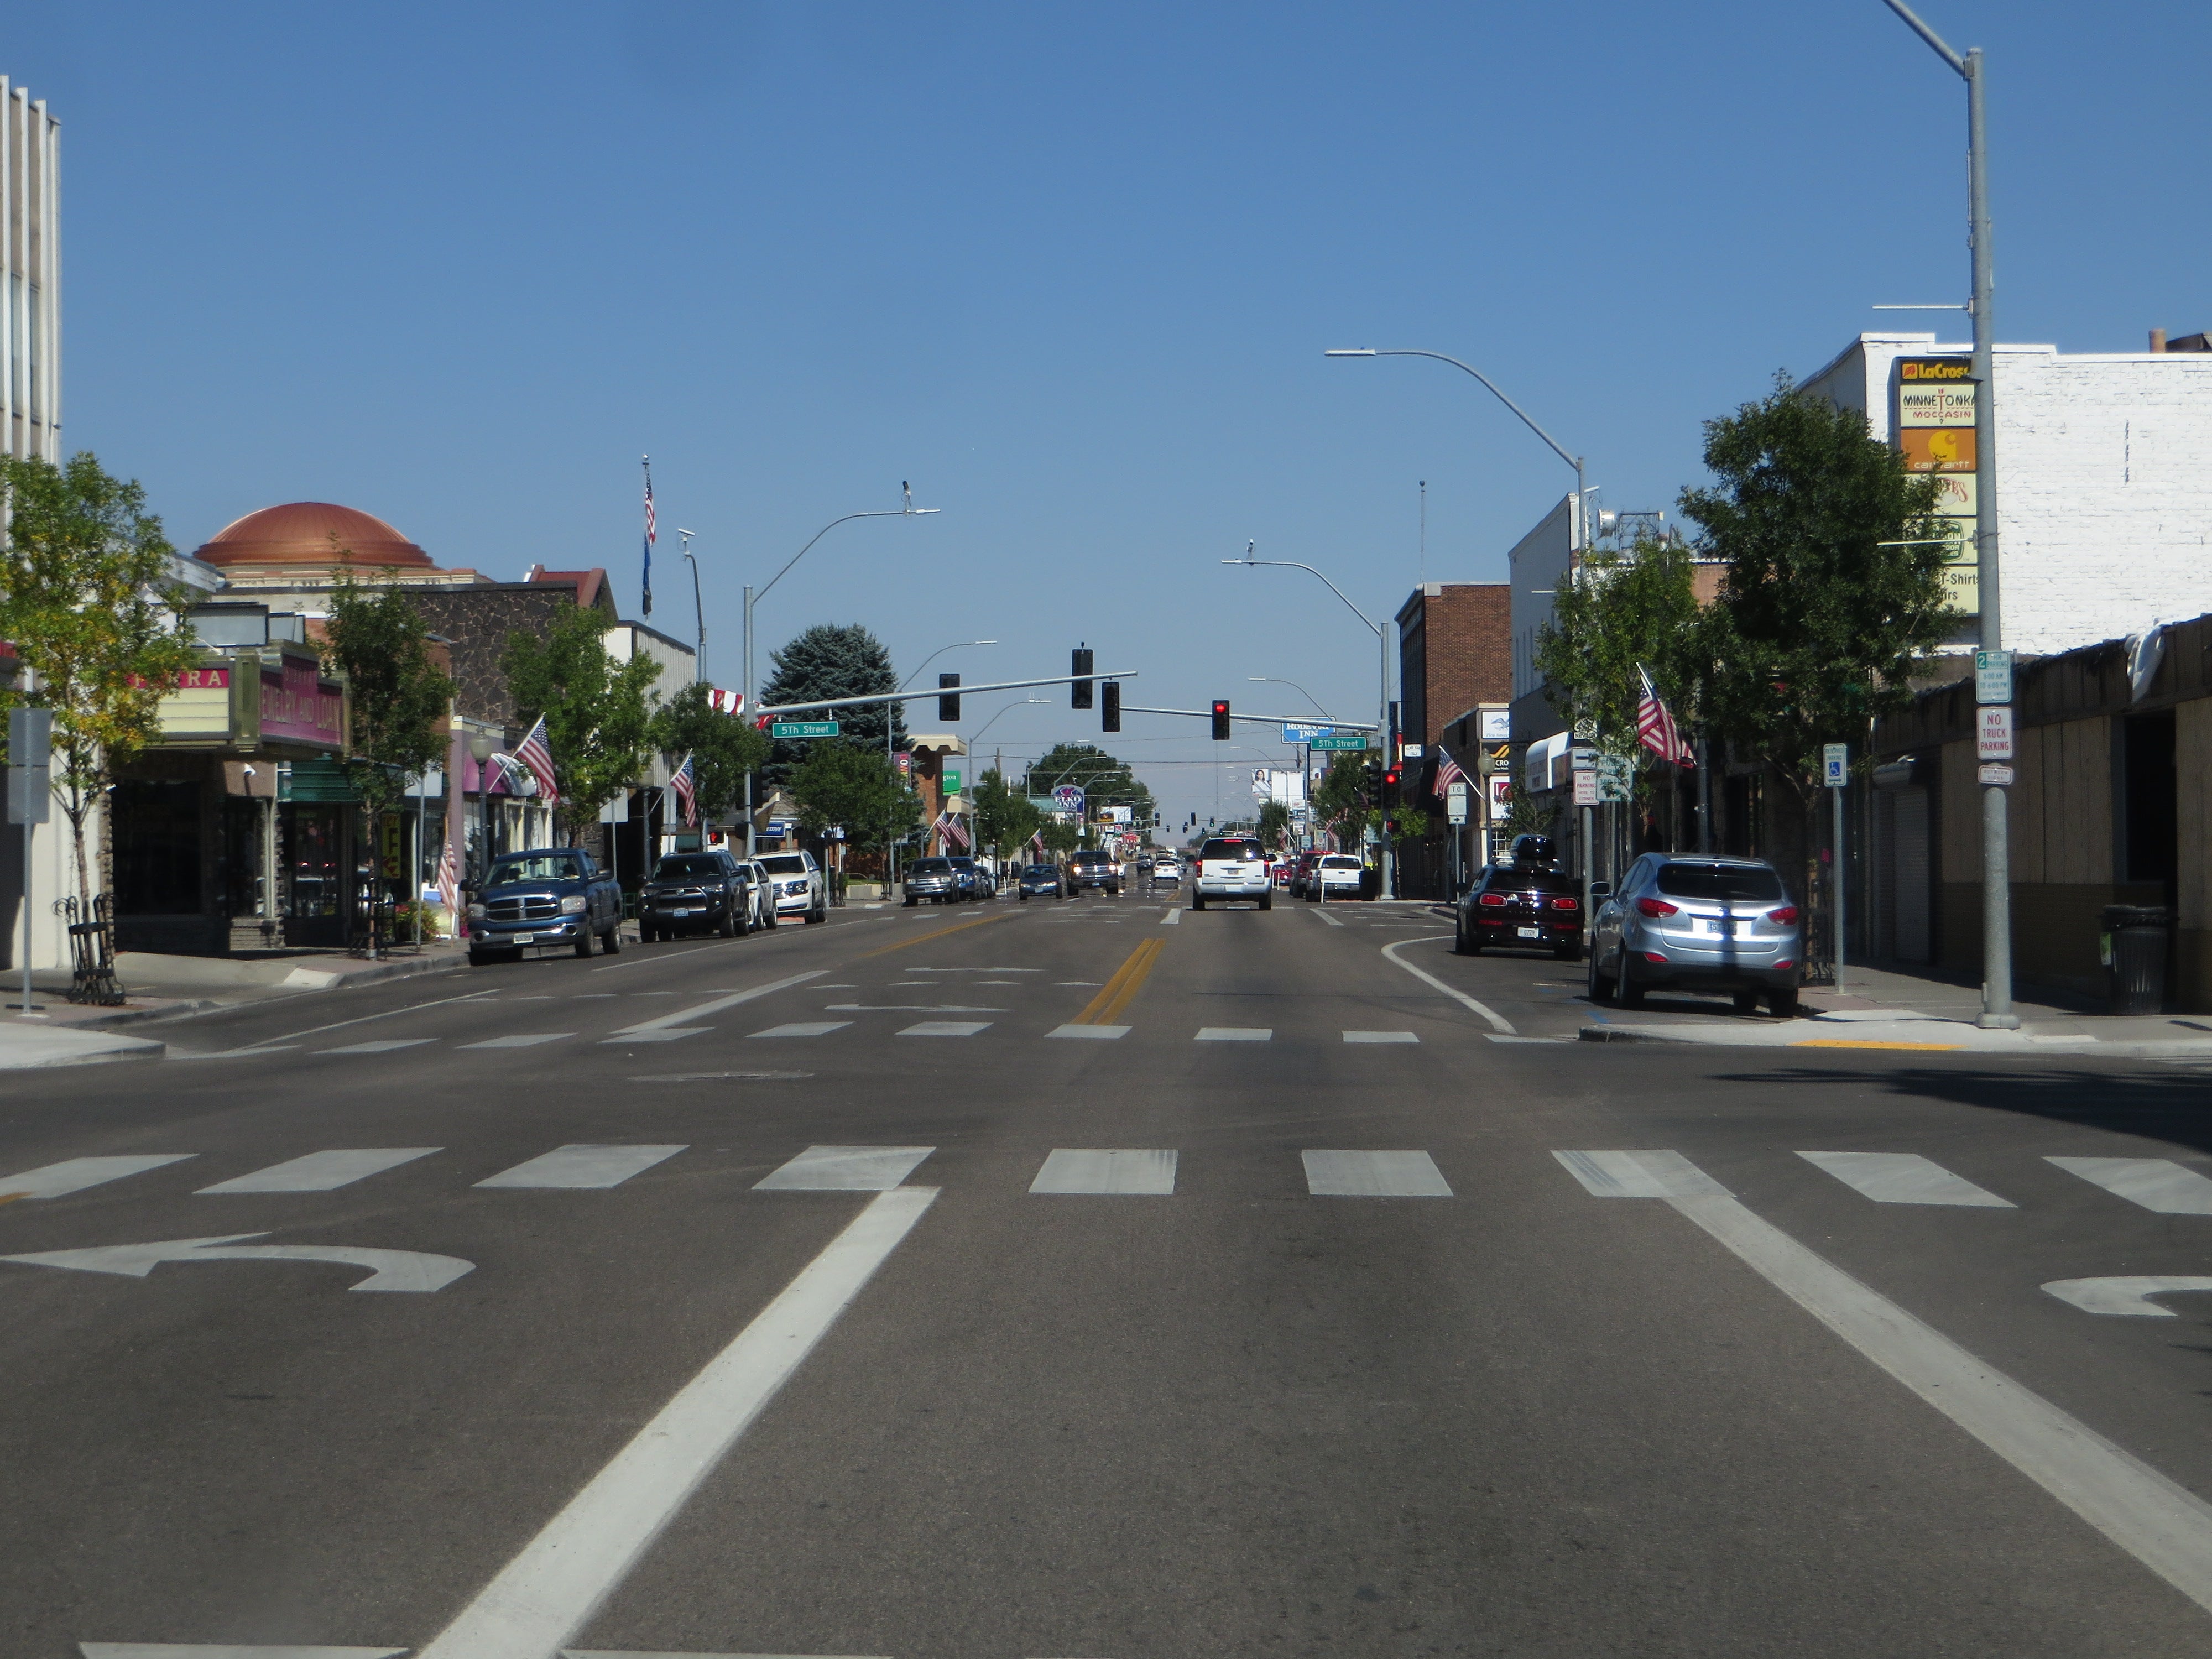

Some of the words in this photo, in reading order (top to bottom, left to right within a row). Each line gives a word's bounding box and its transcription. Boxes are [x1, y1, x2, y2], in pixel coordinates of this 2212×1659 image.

[1914, 461, 1969, 469] carartt
[1942, 573, 1978, 585] T-Shirt
[1978, 655, 1985, 668] 2
[317, 695, 340, 732] LOAN
[1987, 714, 2001, 725] NO
[782, 726, 799, 734] 5Th
[803, 725, 829, 734] Street
[1299, 730, 1318, 739] INN
[1983, 728, 2006, 738] TRUCK
[1980, 742, 2009, 751] PARKING
